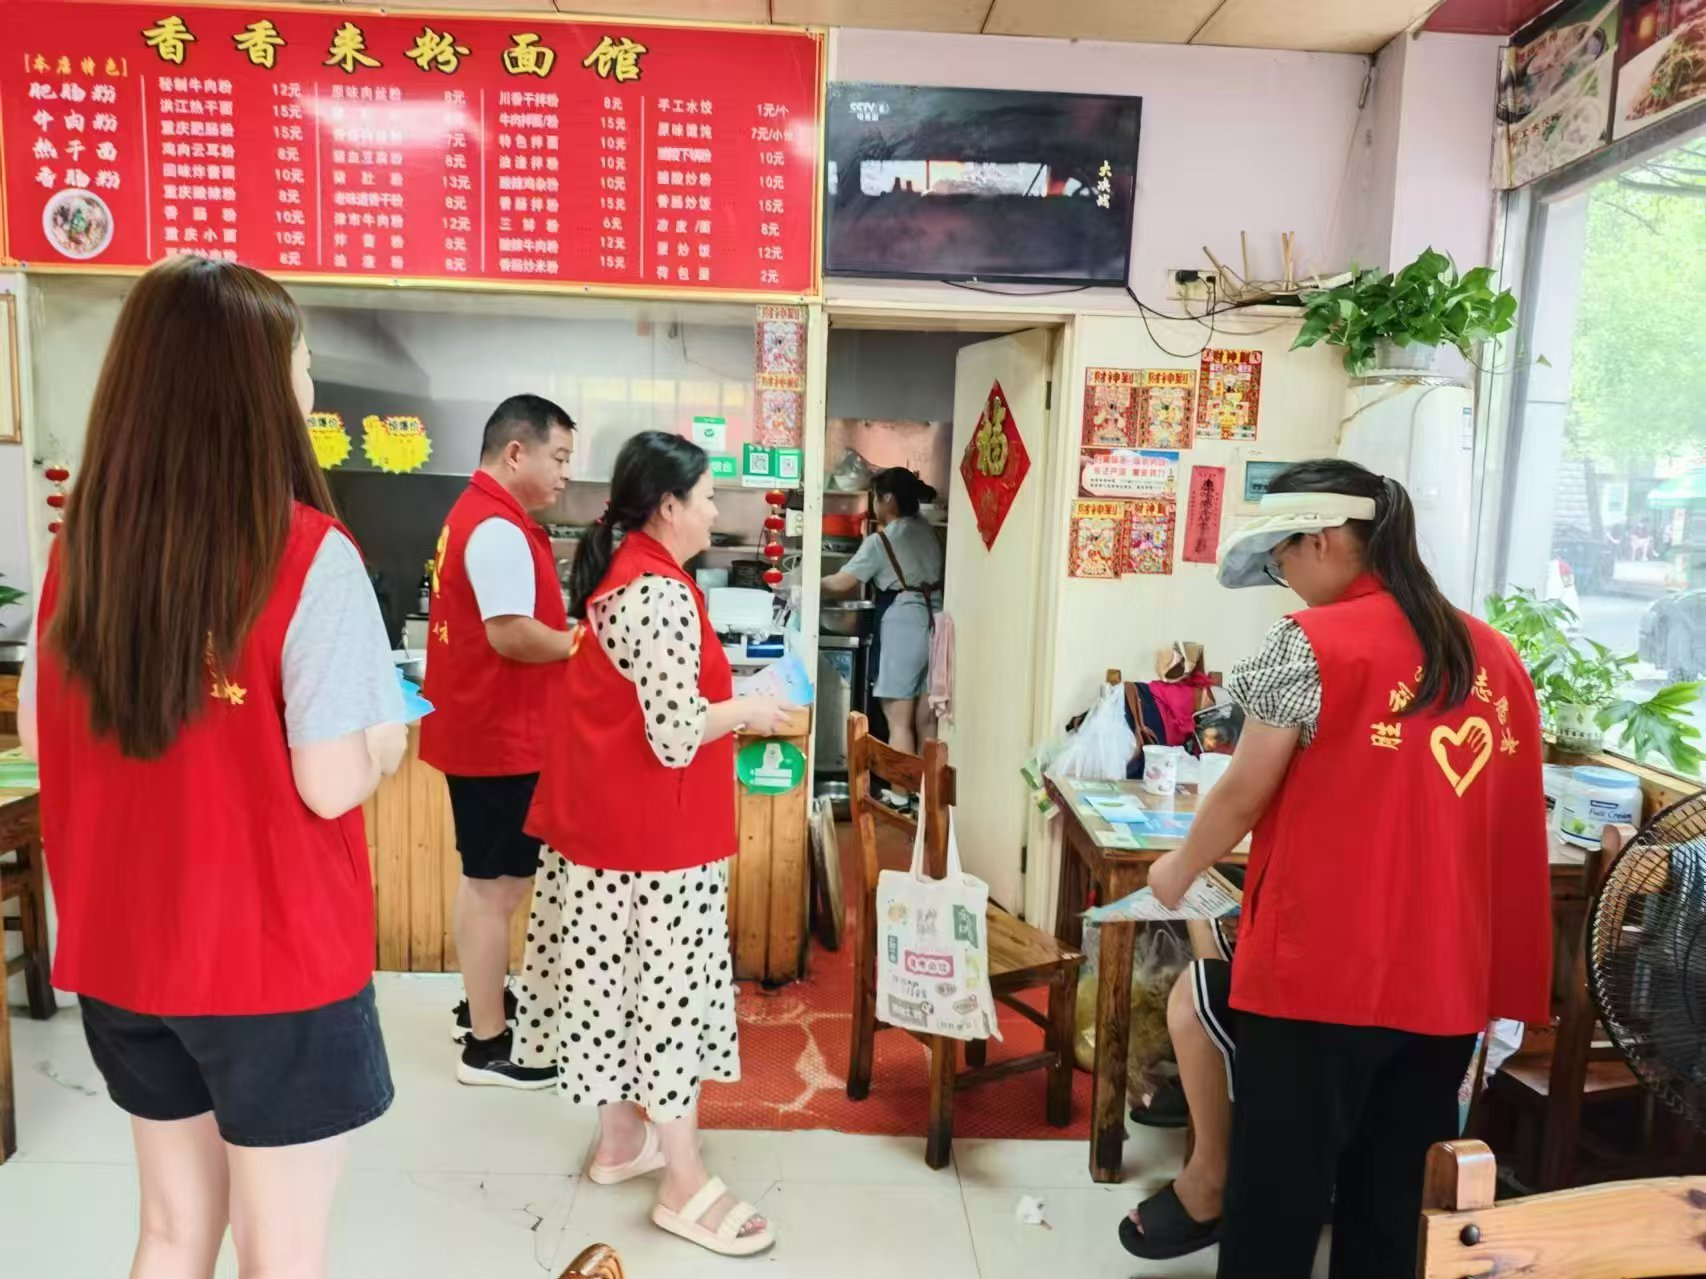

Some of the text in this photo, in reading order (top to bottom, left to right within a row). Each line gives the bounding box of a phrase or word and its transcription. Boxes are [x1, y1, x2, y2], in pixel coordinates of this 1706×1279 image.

[141, 15, 649, 83] 香香来粉面馆
[272, 82, 304, 101] 12元
[273, 101, 305, 120] 15元
[657, 98, 713, 115] 手工水饺
[757, 102, 790, 119] 1元/个
[32, 108, 118, 132] 牛肉粉
[601, 116, 627, 131] 15元
[273, 125, 304, 141] 15元
[31, 136, 118, 162] 热干面
[600, 136, 627, 151] 10元
[600, 156, 626, 171] 10元
[759, 151, 785, 166] 10元
[34, 165, 121, 190] 香肠粉
[275, 167, 305, 184] 10元
[442, 175, 472, 190] 13元
[759, 175, 785, 190] 10元
[600, 176, 626, 191] 10元
[600, 197, 626, 211] 15元
[276, 209, 305, 225] 10元
[442, 216, 471, 231] 12元
[164, 226, 238, 243] 重庆小面
[276, 231, 305, 246] 10元
[600, 236, 626, 250] 12元
[758, 246, 784, 260] 12元
[600, 255, 626, 269] 15元
[760, 269, 779, 284] 2元
[976, 395, 1009, 477] 福
